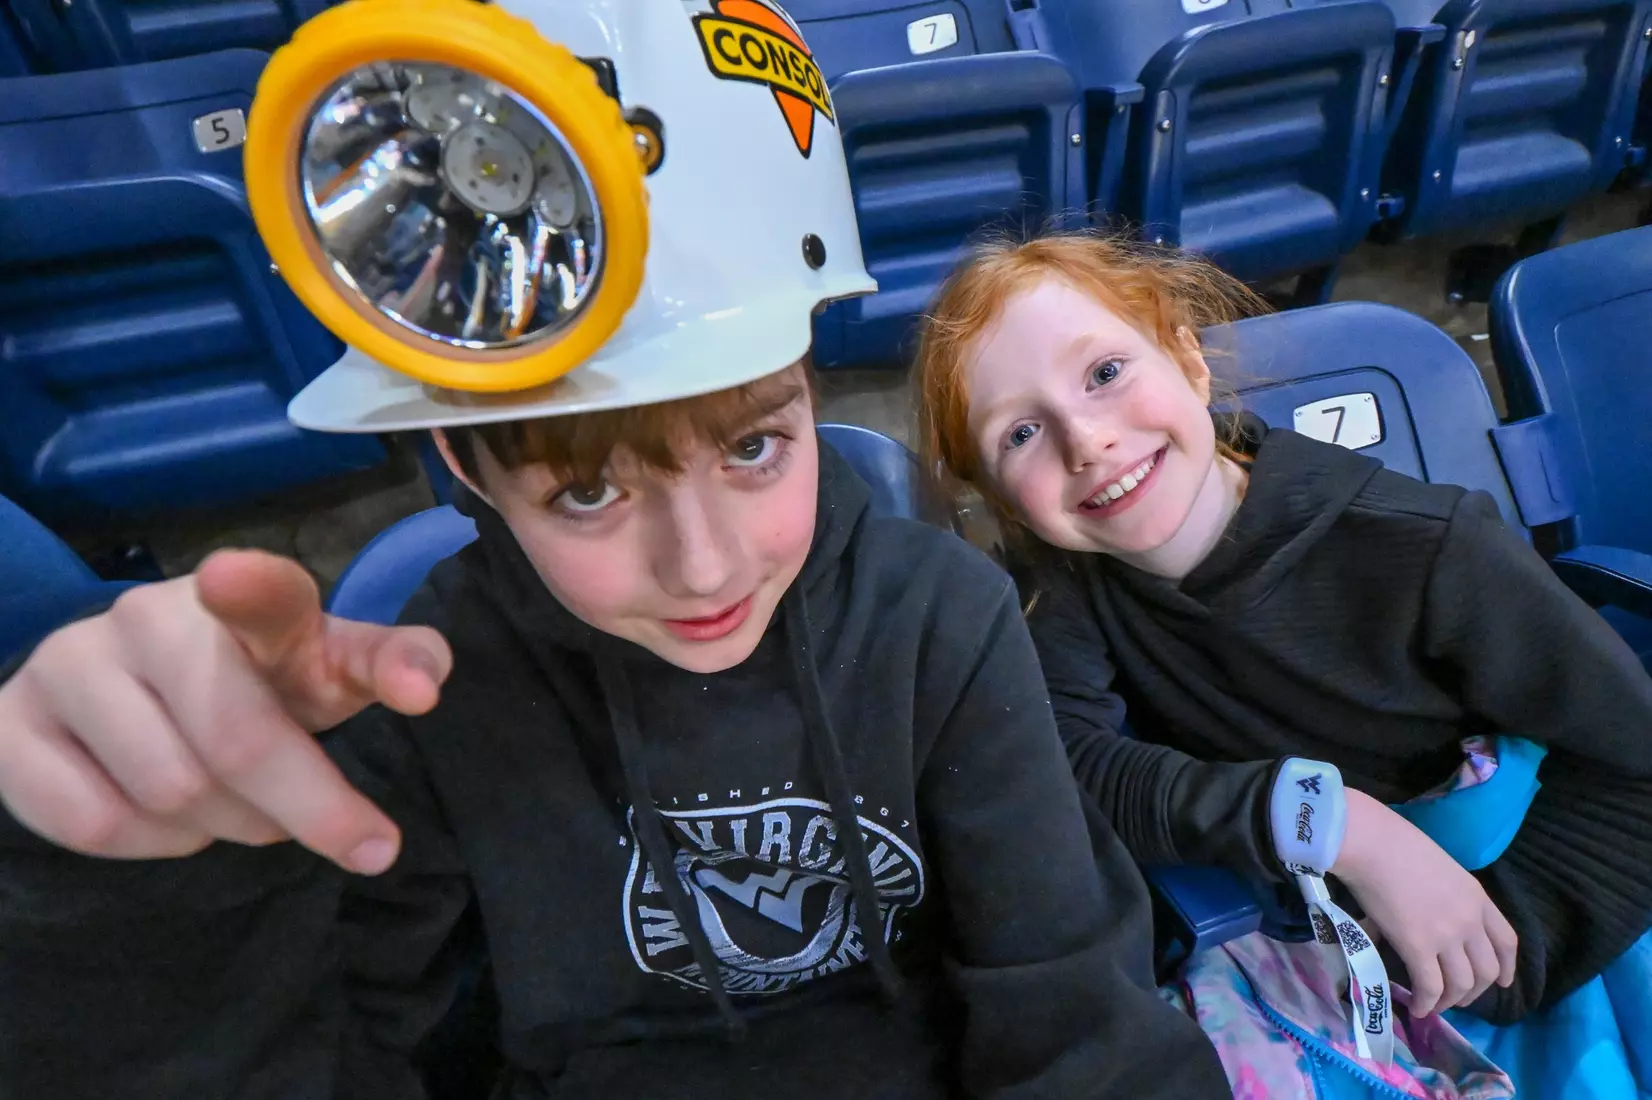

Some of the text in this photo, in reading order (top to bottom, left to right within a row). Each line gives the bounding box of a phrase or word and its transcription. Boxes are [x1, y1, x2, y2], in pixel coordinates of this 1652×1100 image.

[924, 22, 937, 45] 7
[713, 28, 831, 108] CONSOL
[211, 117, 229, 144] 5
[1321, 406, 1345, 443] 7
[854, 794, 909, 828] 867
